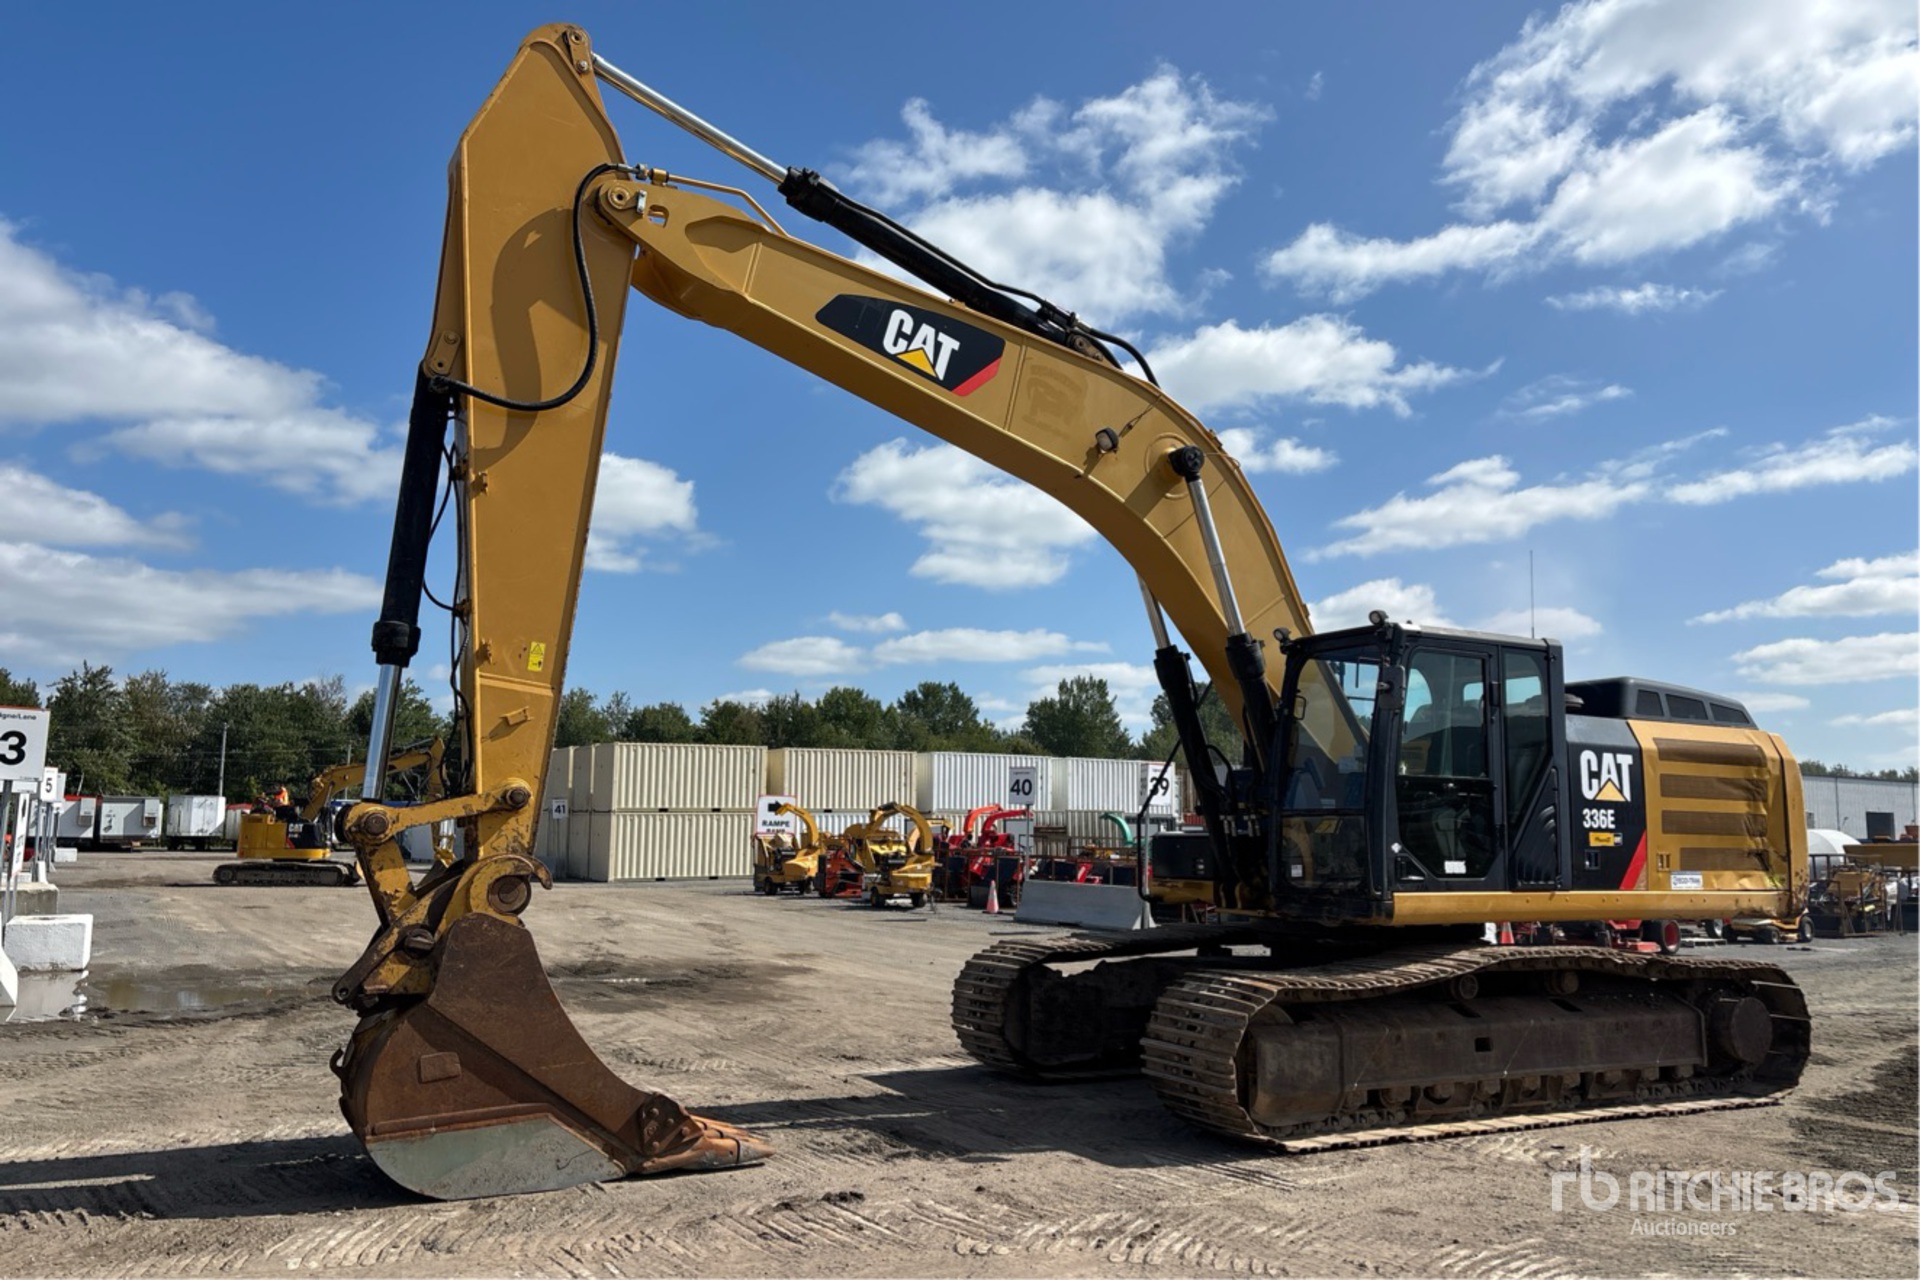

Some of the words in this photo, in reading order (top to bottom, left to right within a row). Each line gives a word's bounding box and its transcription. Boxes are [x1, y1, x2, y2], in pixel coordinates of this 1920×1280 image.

[883, 309, 961, 381] CAT
[0, 730, 27, 766] 3
[45, 777, 53, 793] 5
[1580, 750, 1633, 802] CAT
[1010, 778, 1033, 796] 40
[554, 804, 566, 814] 41
[289, 823, 304, 832] CAT
[762, 820, 790, 828] RAMPE
[1582, 808, 1616, 829] 336E
